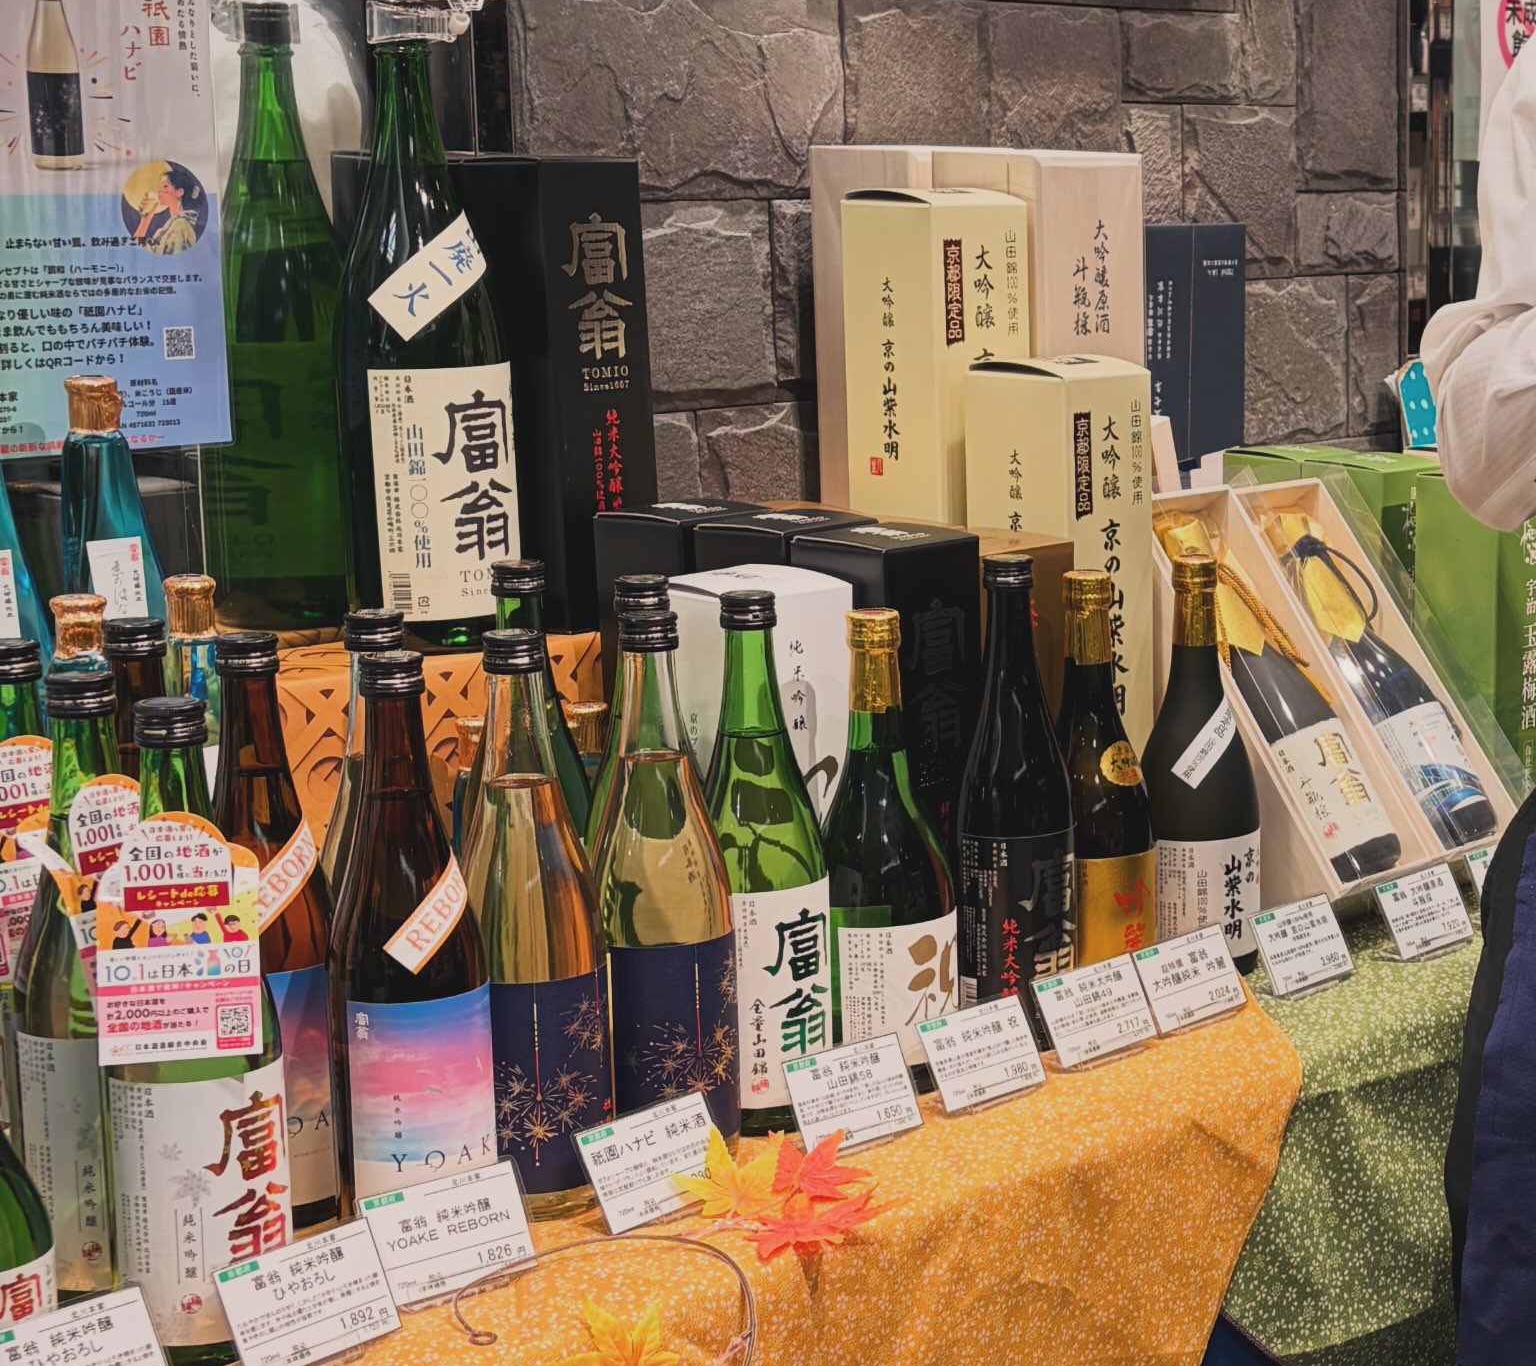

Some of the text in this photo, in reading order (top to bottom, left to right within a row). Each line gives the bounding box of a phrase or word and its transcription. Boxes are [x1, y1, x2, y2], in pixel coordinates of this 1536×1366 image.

[120, 24, 143, 81] ハナビ
[561, 211, 633, 361] 富翁
[881, 275, 896, 328] 大吟醸
[946, 244, 963, 340] 京都限定品
[973, 243, 997, 330] 大吟醸
[582, 365, 630, 380] TOMIO
[431, 388, 513, 562] 富翁
[1008, 448, 1023, 501] 大吟醸
[1075, 418, 1092, 512] 京都限定品
[1100, 415, 1122, 501] 大吟醸
[788, 639, 808, 732] 純米吟醸
[1313, 730, 1370, 808] 富翁
[128, 843, 223, 862] 全国の地酒が
[1223, 853, 1245, 941] 山紫水明
[762, 907, 829, 1055] 富翁
[144, 1087, 155, 1119] 日本酒
[589, 1112, 707, 1167] 祇園ハナビ 純米酒
[81, 1164, 99, 1228] 純米吟醸
[203, 1089, 293, 1266] 富翁
[386, 1209, 511, 1253] YOAKE REBORN
[398, 1197, 492, 1234] 富翁 純米吟醸
[182, 1213, 199, 1279] 純米吟醸
[250, 1246, 345, 1291] 富翁 純米吟醸
[272, 1269, 336, 1302] ひやおろし
[4, 1315, 115, 1363] 富翁 純米吟醸
[340, 1306, 375, 1331] 1,892
